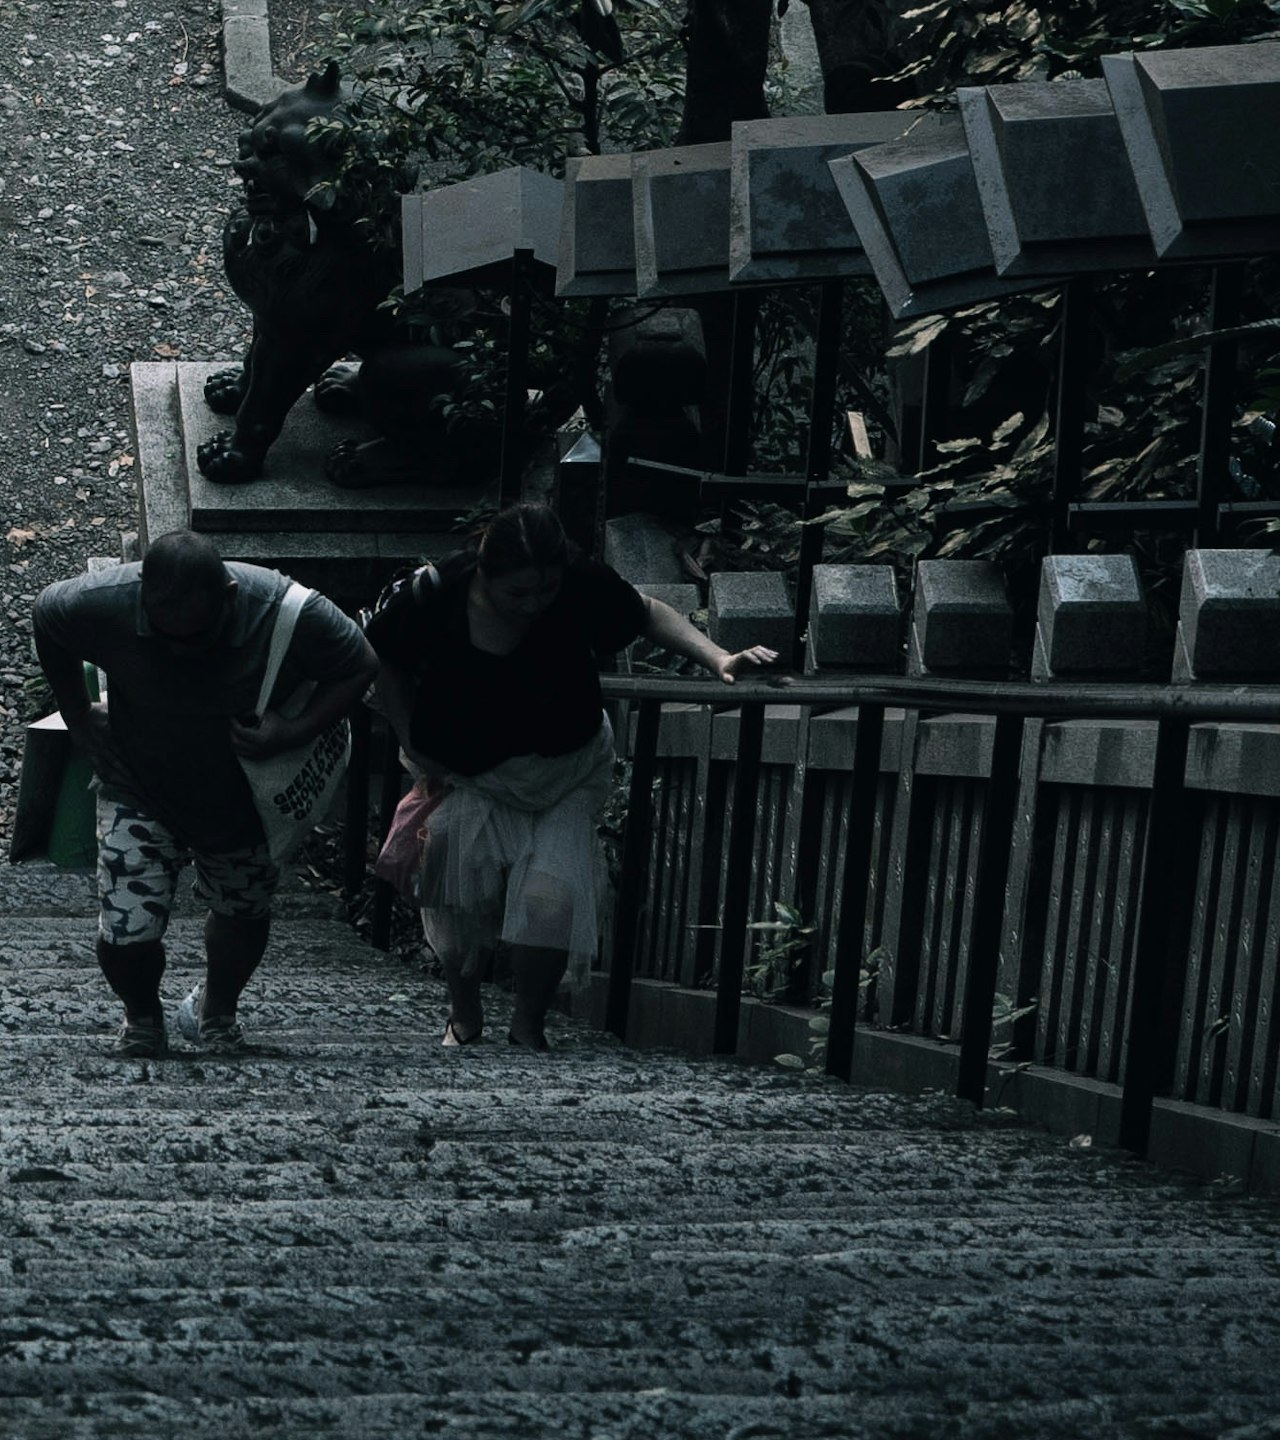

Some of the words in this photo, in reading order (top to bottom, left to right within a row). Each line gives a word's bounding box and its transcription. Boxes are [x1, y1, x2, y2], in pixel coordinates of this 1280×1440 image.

[274, 759, 314, 805] GREAT
[280, 759, 325, 814] SHOULD
[294, 799, 312, 820] GO
[312, 777, 325, 799] TO
